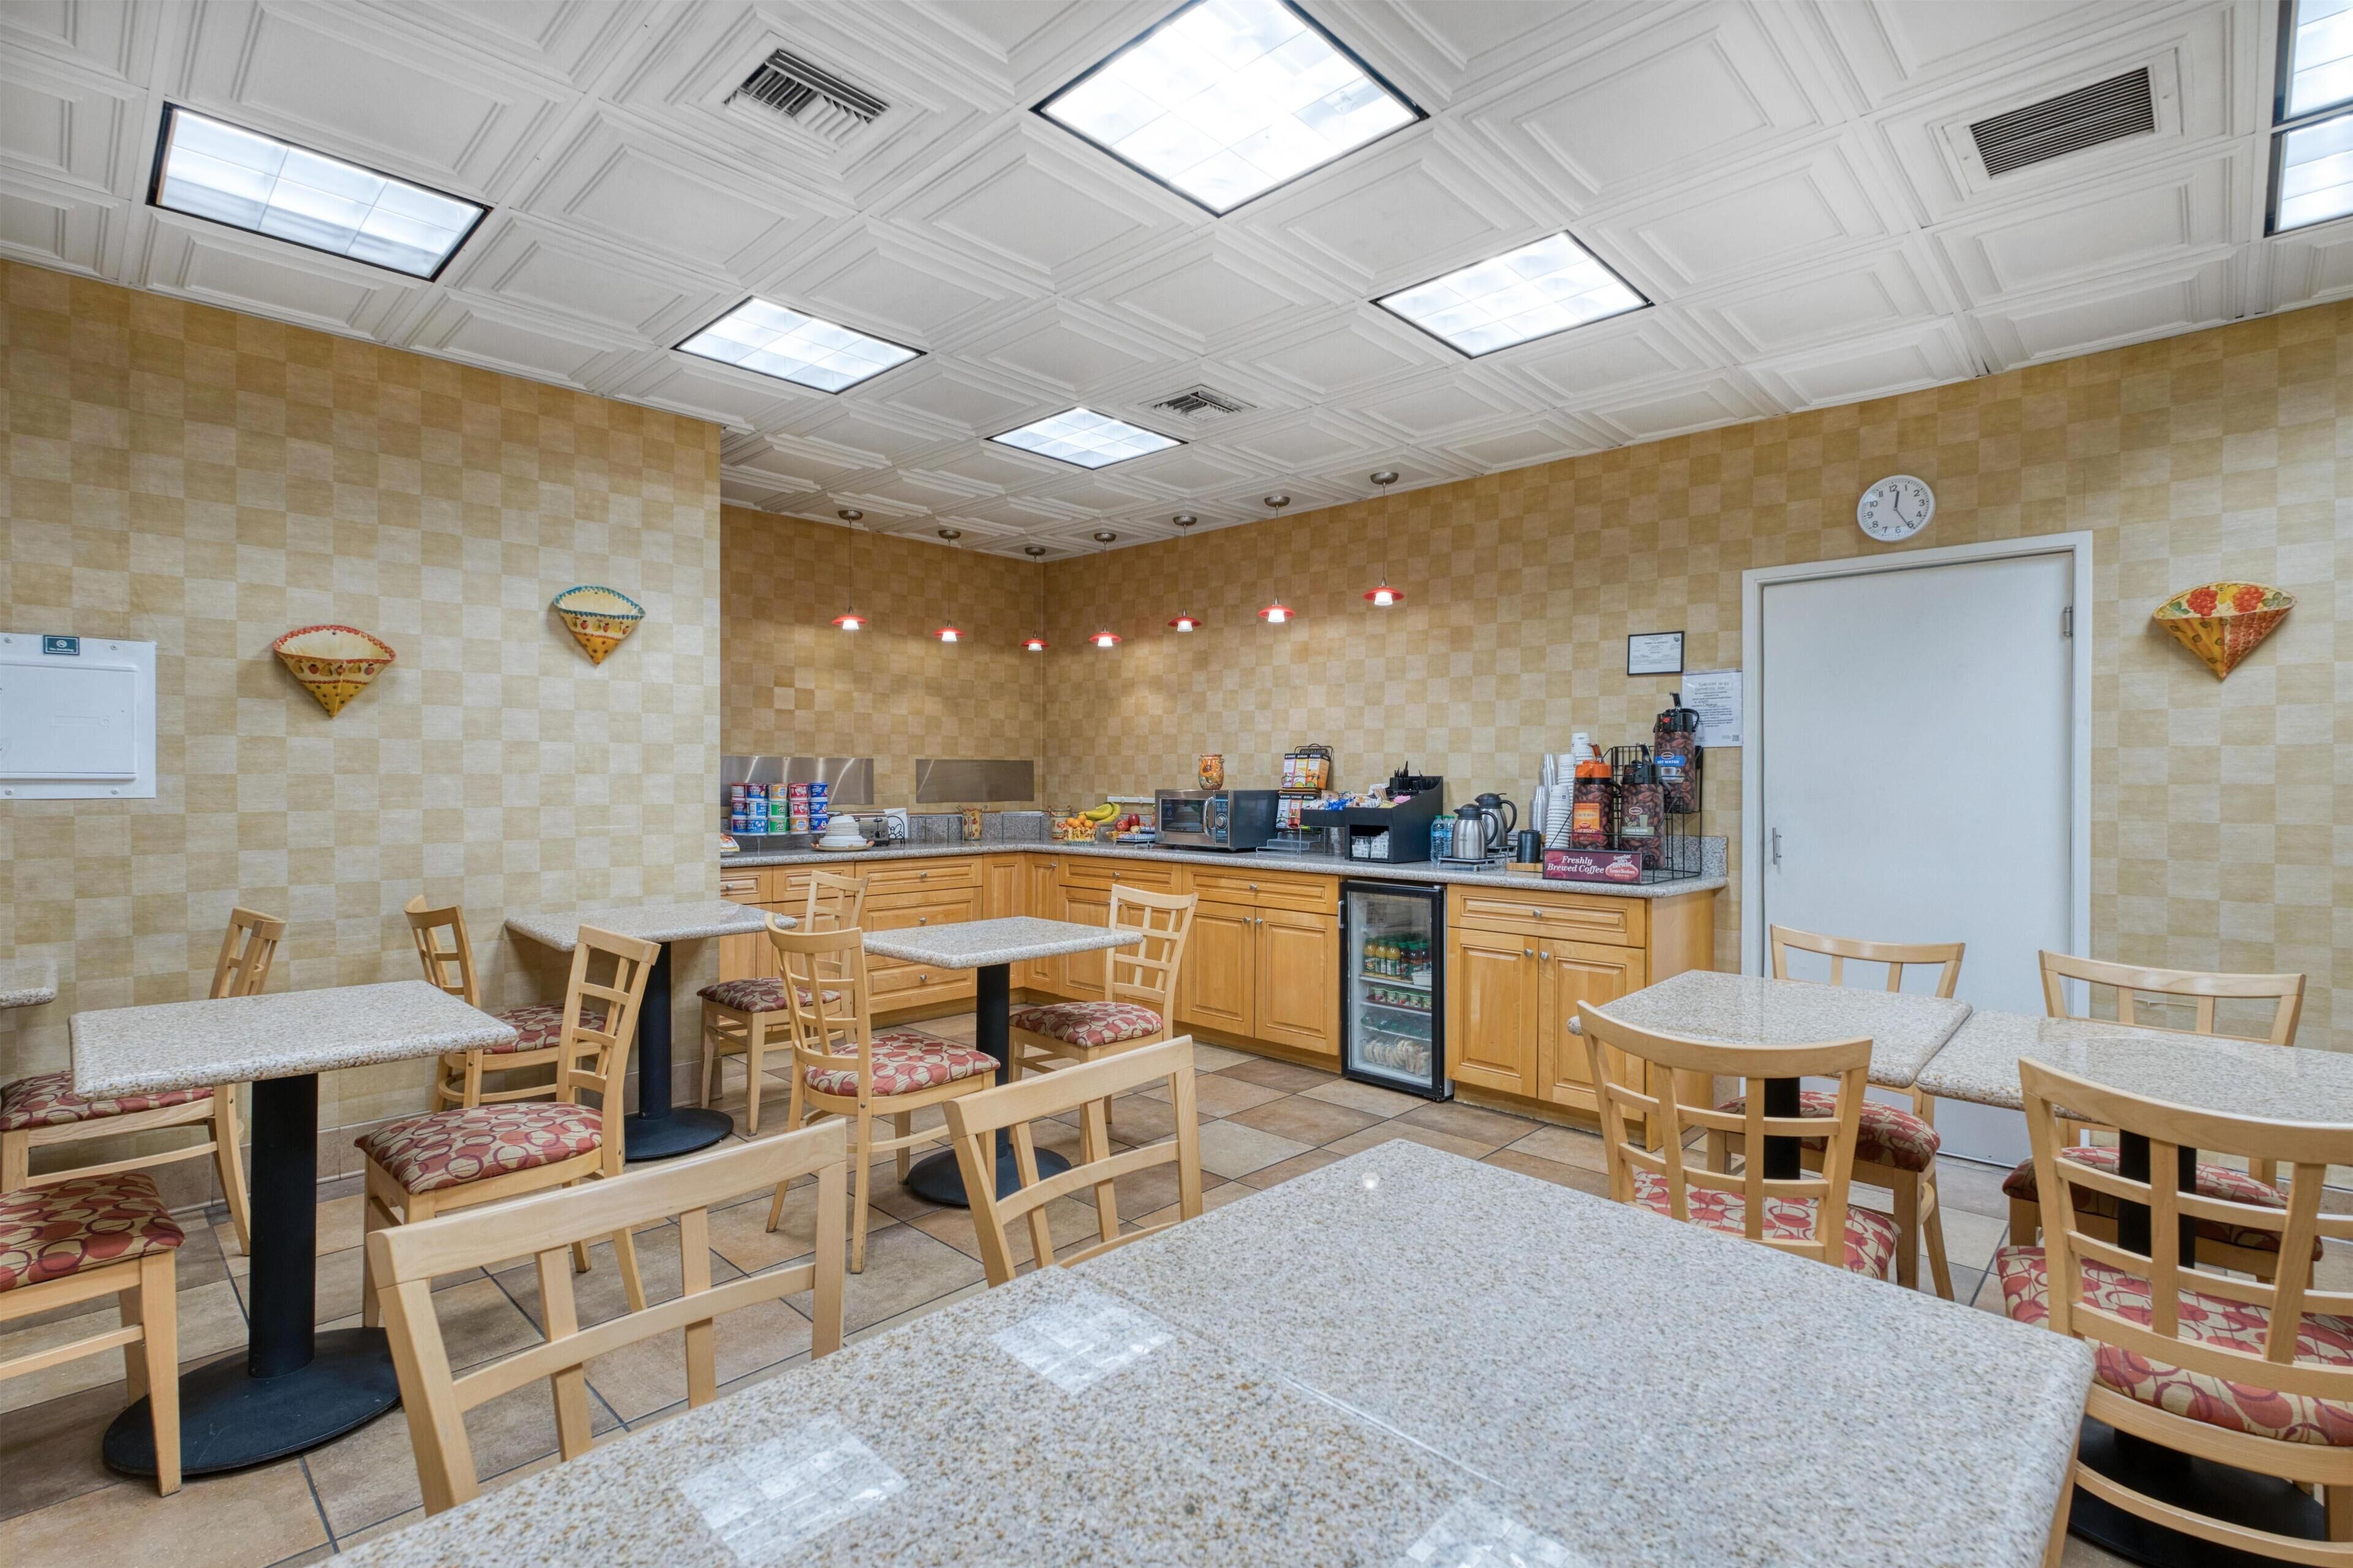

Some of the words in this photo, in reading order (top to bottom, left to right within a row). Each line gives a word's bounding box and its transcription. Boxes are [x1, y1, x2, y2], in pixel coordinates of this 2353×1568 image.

[1563, 855, 1593, 866] Freshly
[1547, 863, 1577, 872] Brewed
[1578, 865, 1605, 874] Coffee
